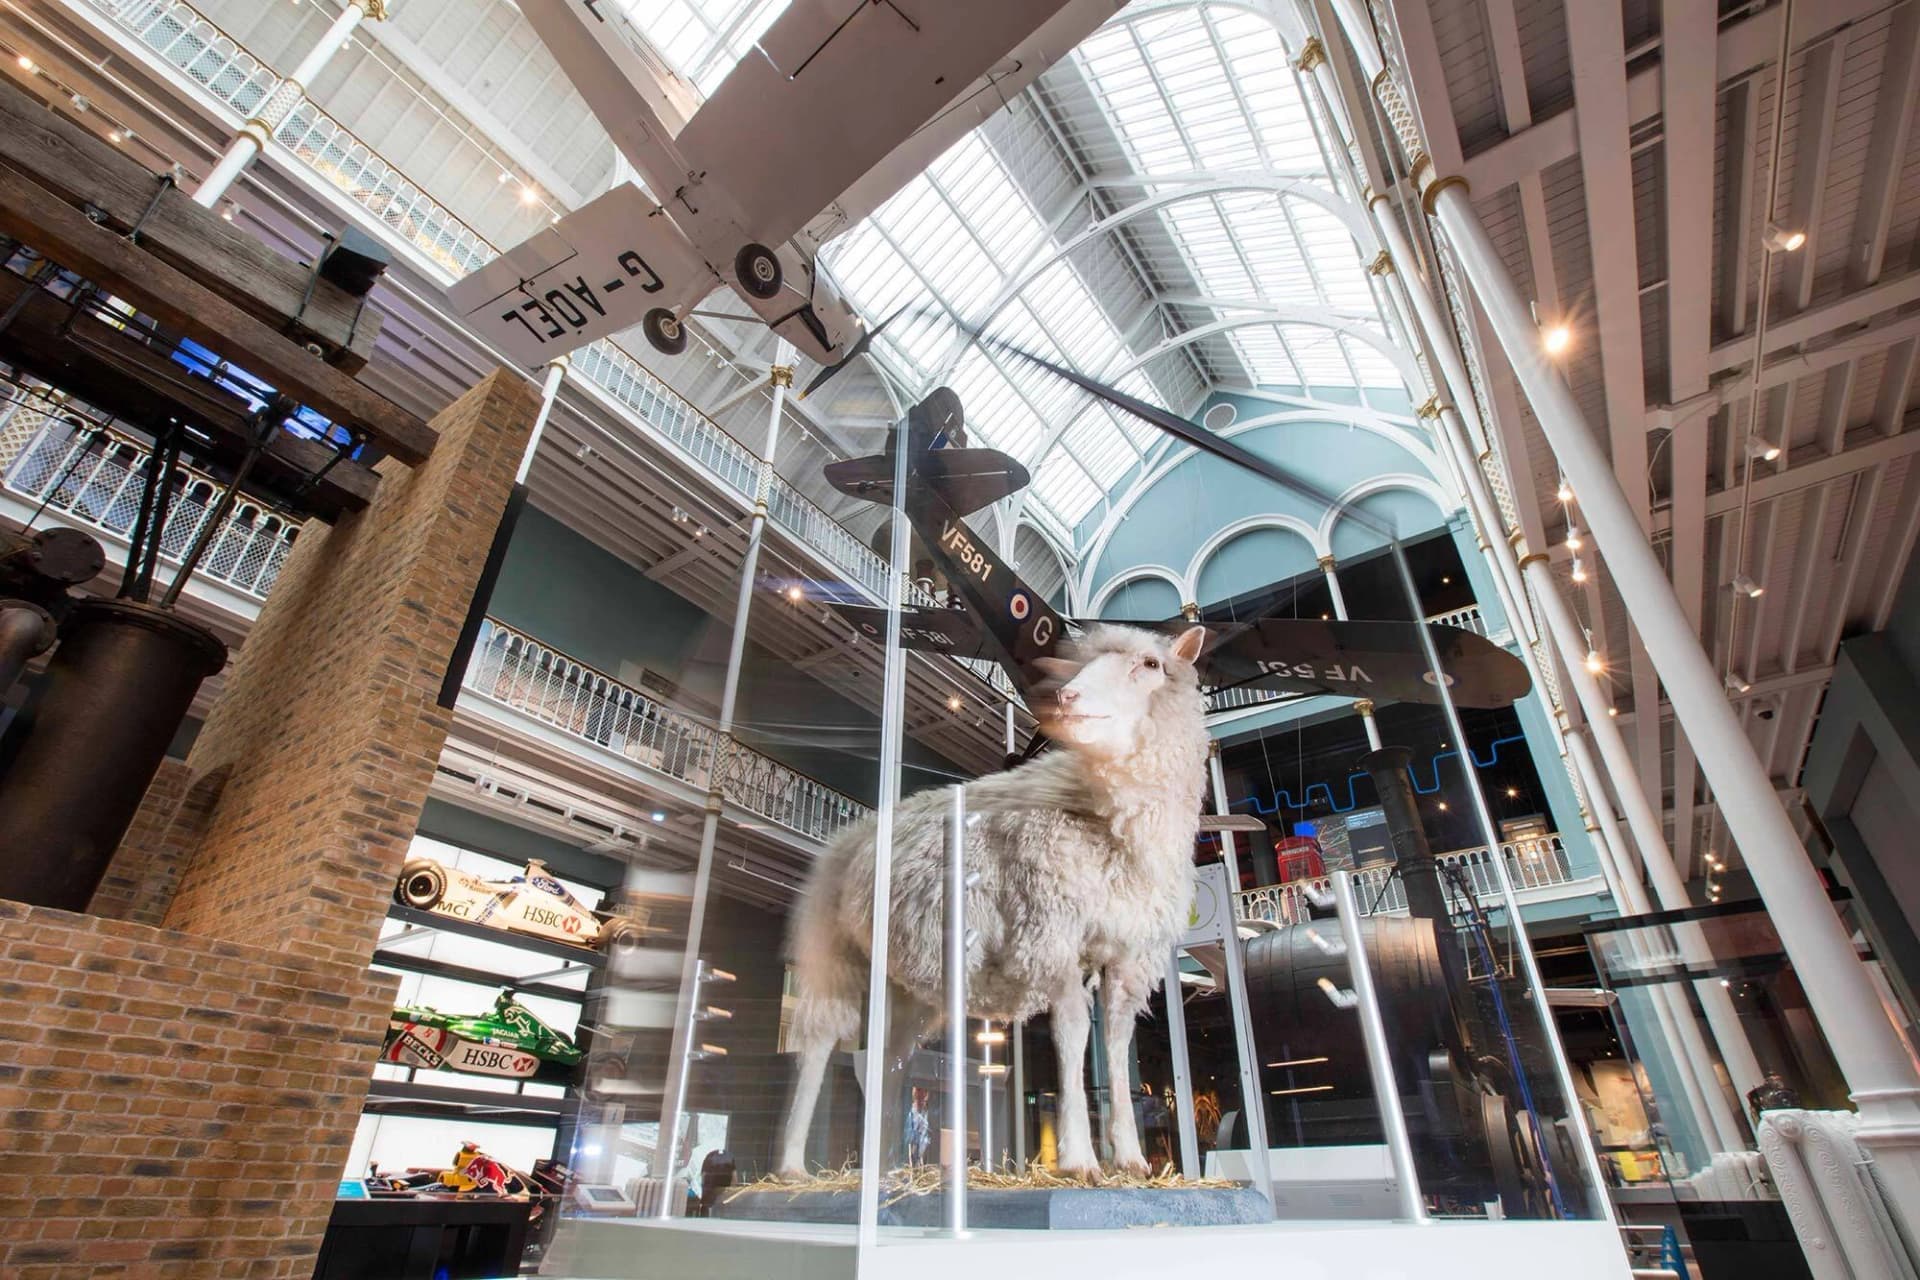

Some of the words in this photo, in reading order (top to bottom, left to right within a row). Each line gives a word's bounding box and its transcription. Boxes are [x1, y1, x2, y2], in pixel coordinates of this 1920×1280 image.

[501, 250, 665, 344] G-AOEL
[939, 519, 993, 582] VF581
[1032, 615, 1054, 647] G
[1324, 665, 1373, 683] VF
[536, 877, 560, 895] Ford
[436, 900, 470, 917] MCI
[522, 904, 563, 929] HSBC
[461, 1048, 514, 1070] HSBC
